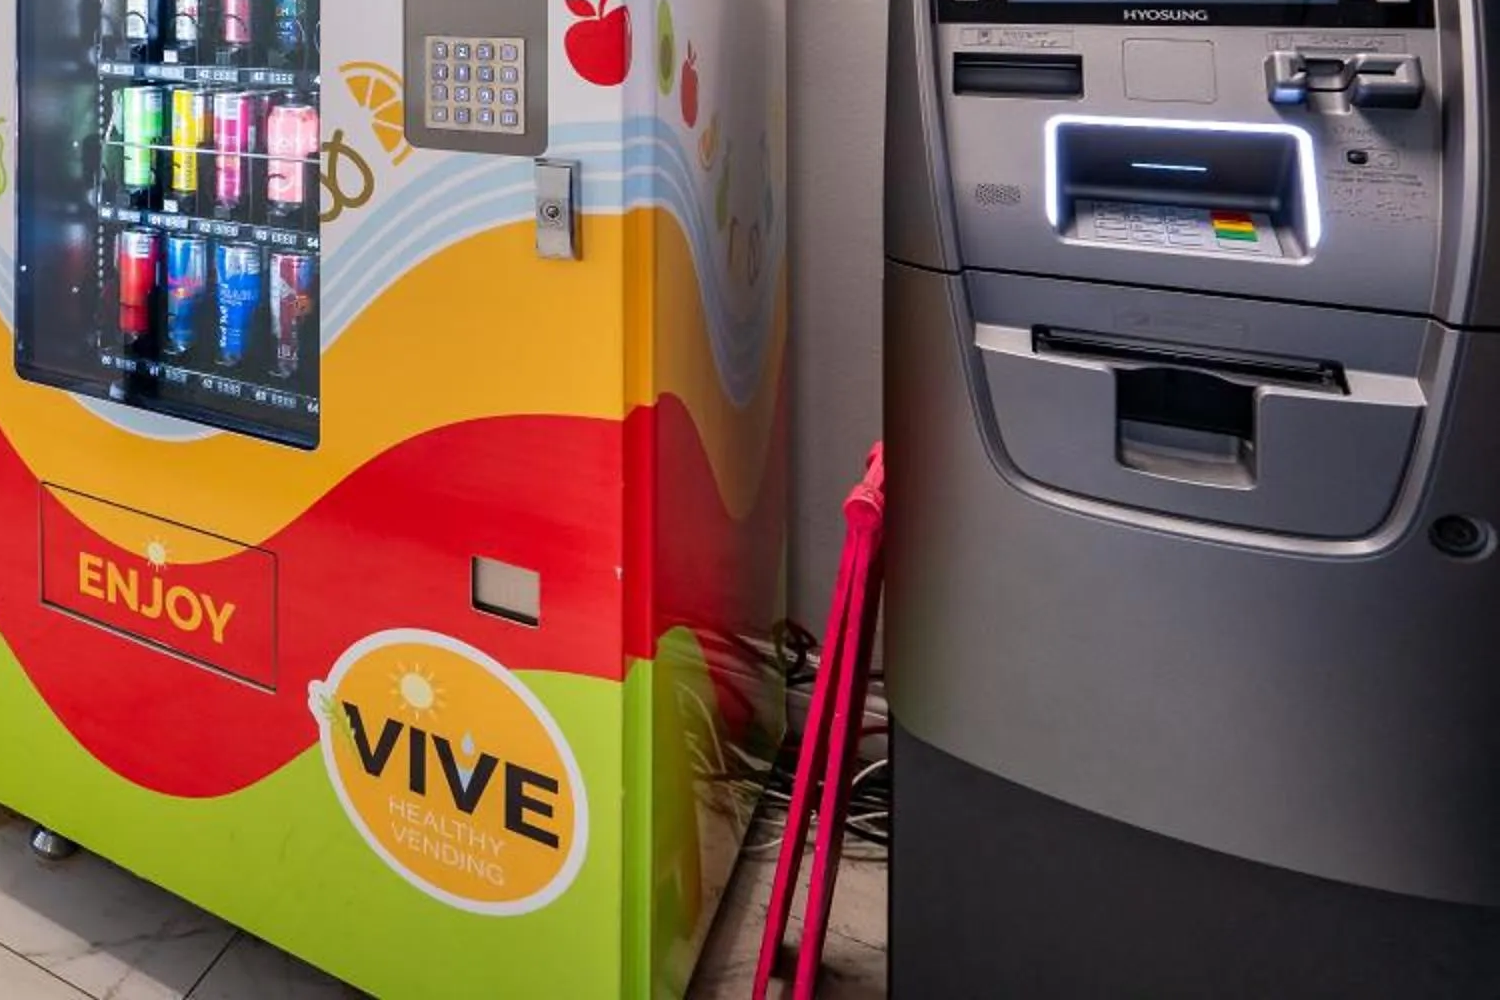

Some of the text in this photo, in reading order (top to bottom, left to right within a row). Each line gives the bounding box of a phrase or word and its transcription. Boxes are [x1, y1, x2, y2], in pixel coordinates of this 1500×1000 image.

[1123, 8, 1208, 21] HYOSUNG
[79, 551, 237, 645] ENJOY
[341, 700, 560, 850] VIVE
[388, 794, 508, 858] HEALTHY
[391, 820, 506, 887] VENDING
